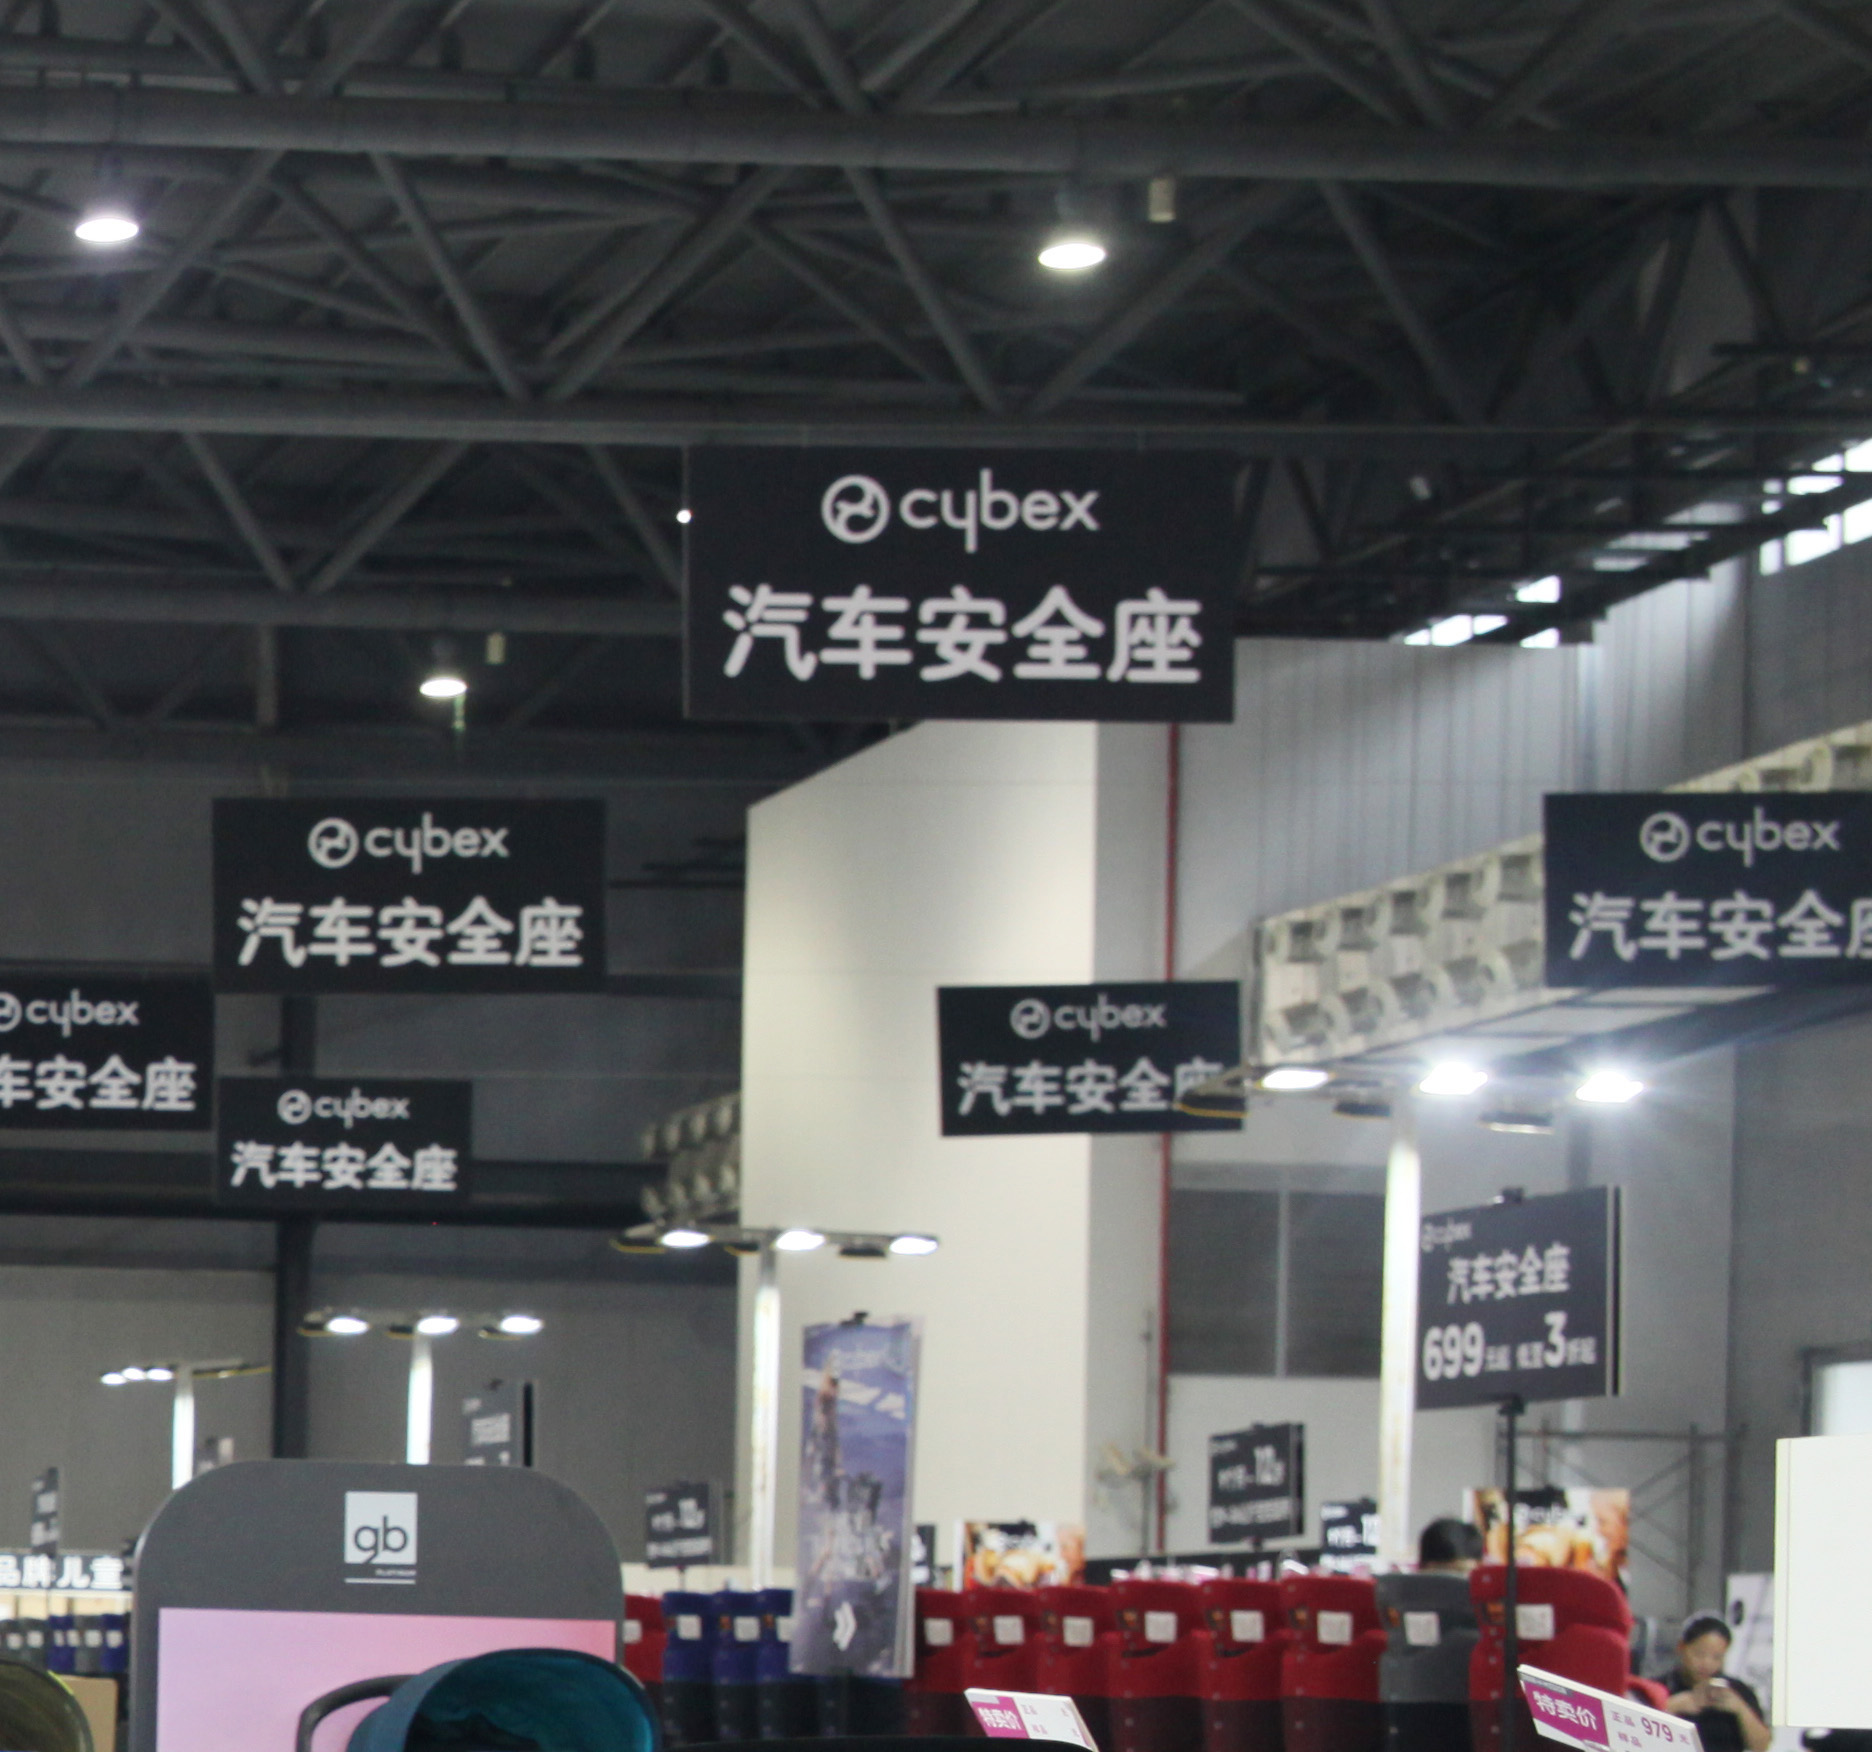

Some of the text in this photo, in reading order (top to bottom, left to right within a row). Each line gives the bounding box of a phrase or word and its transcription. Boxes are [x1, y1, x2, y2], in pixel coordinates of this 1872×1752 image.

[899, 468, 1100, 552] cybex
[723, 585, 1202, 683] 汽车安全座
[364, 813, 510, 874] cybex
[1696, 805, 1840, 867] cybex
[236, 896, 584, 968] 汽车安全座
[26, 990, 140, 1036] cybex
[1055, 993, 1167, 1042] cybex
[313, 1088, 411, 1128] cybex
[229, 1140, 458, 1192] 汽车安全座
[1446, 1241, 1571, 1305] 汽车安全座
[354, 1514, 408, 1564] gb
[1532, 1689, 1598, 1731] 特卖价
[1641, 1716, 1674, 1743] 979
